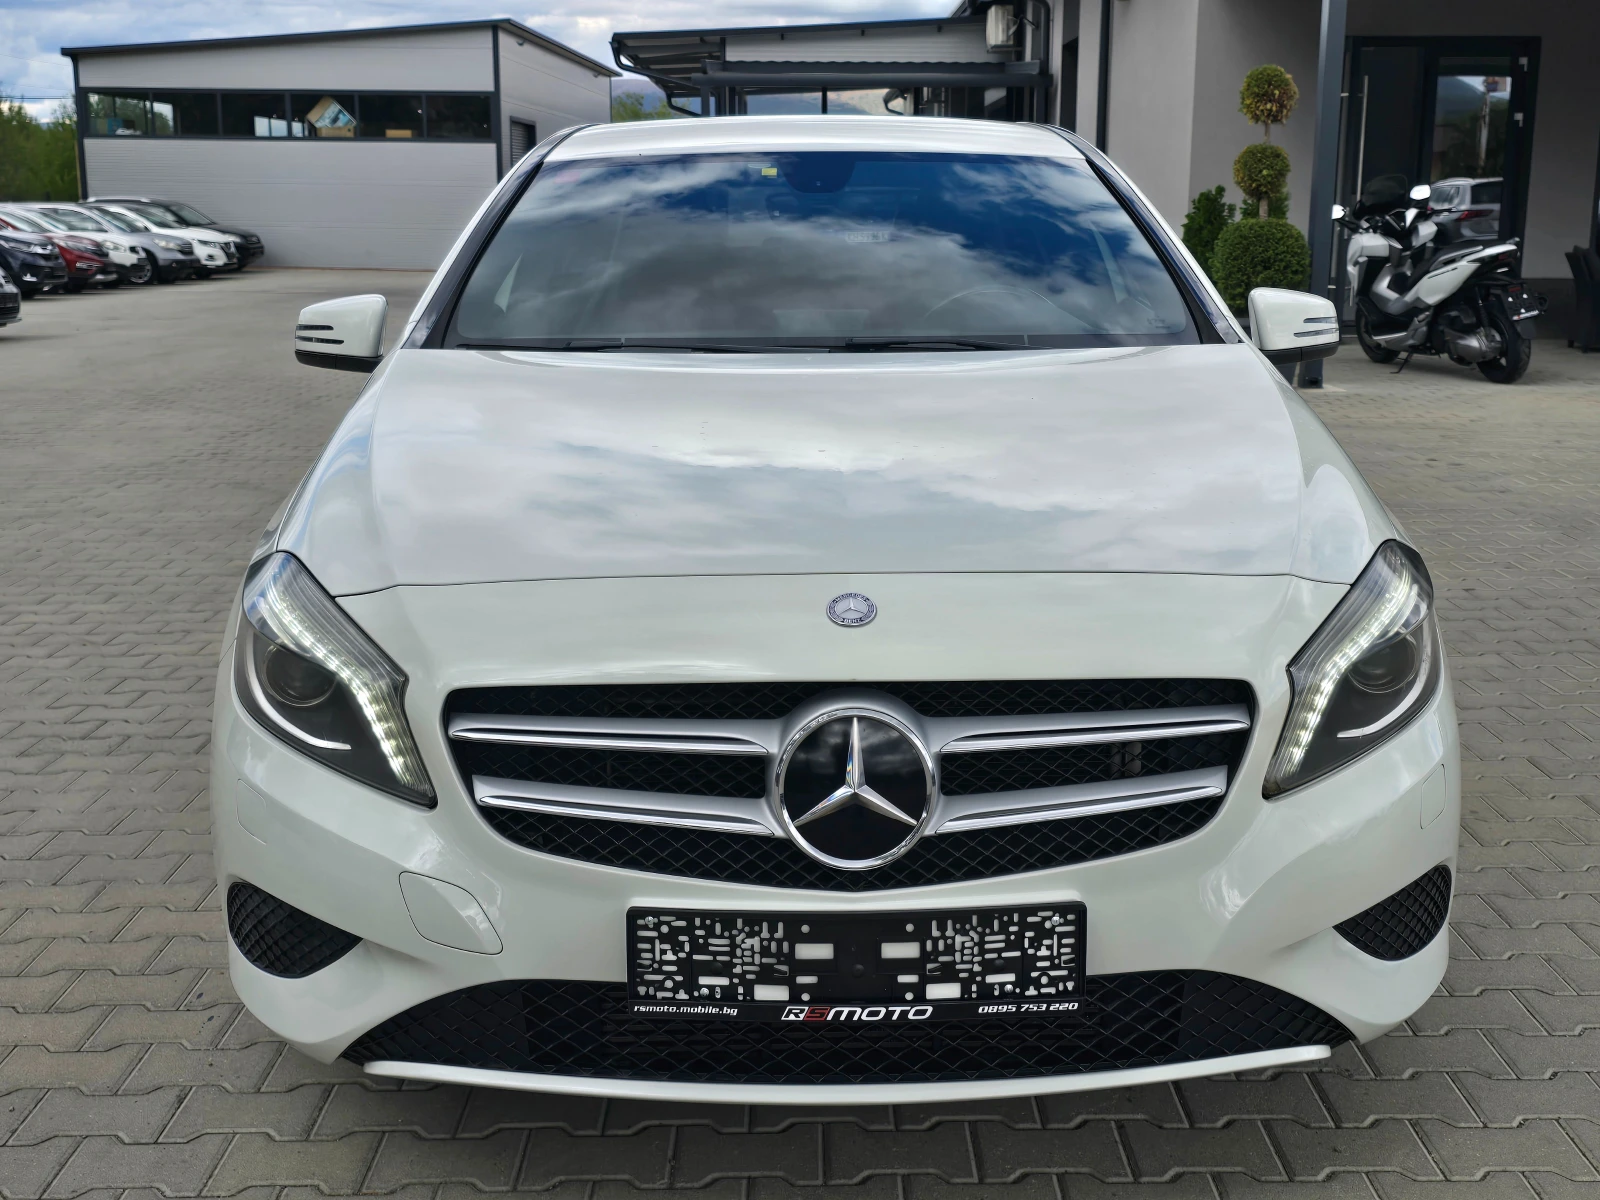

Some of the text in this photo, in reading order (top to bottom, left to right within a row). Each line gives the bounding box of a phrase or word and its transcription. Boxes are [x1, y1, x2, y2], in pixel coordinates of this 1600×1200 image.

[634, 1005, 738, 1016] rsmoto.mobile.bg
[978, 1002, 1079, 1013] 0895 753 220
[781, 1006, 934, 1021] RSMOTO
